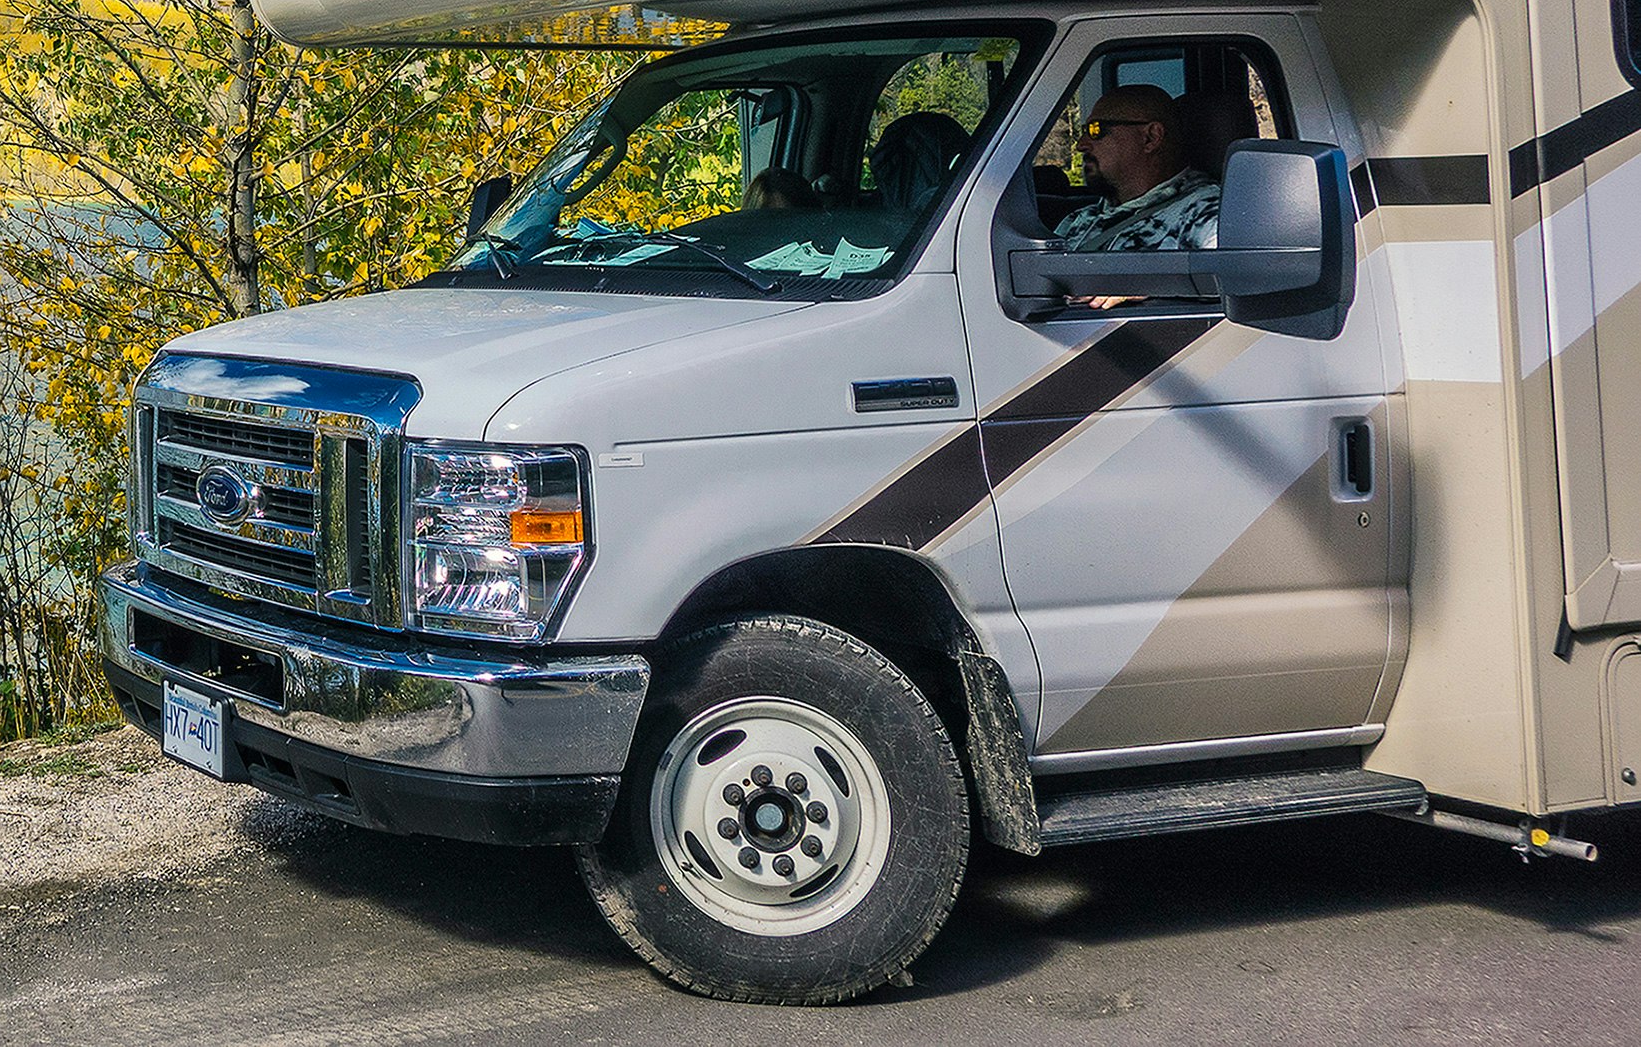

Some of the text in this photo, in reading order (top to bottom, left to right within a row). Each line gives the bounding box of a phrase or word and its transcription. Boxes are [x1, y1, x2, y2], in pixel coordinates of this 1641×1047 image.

[900, 398, 954, 408] SUPER DUTY
[204, 480, 229, 506] Ford
